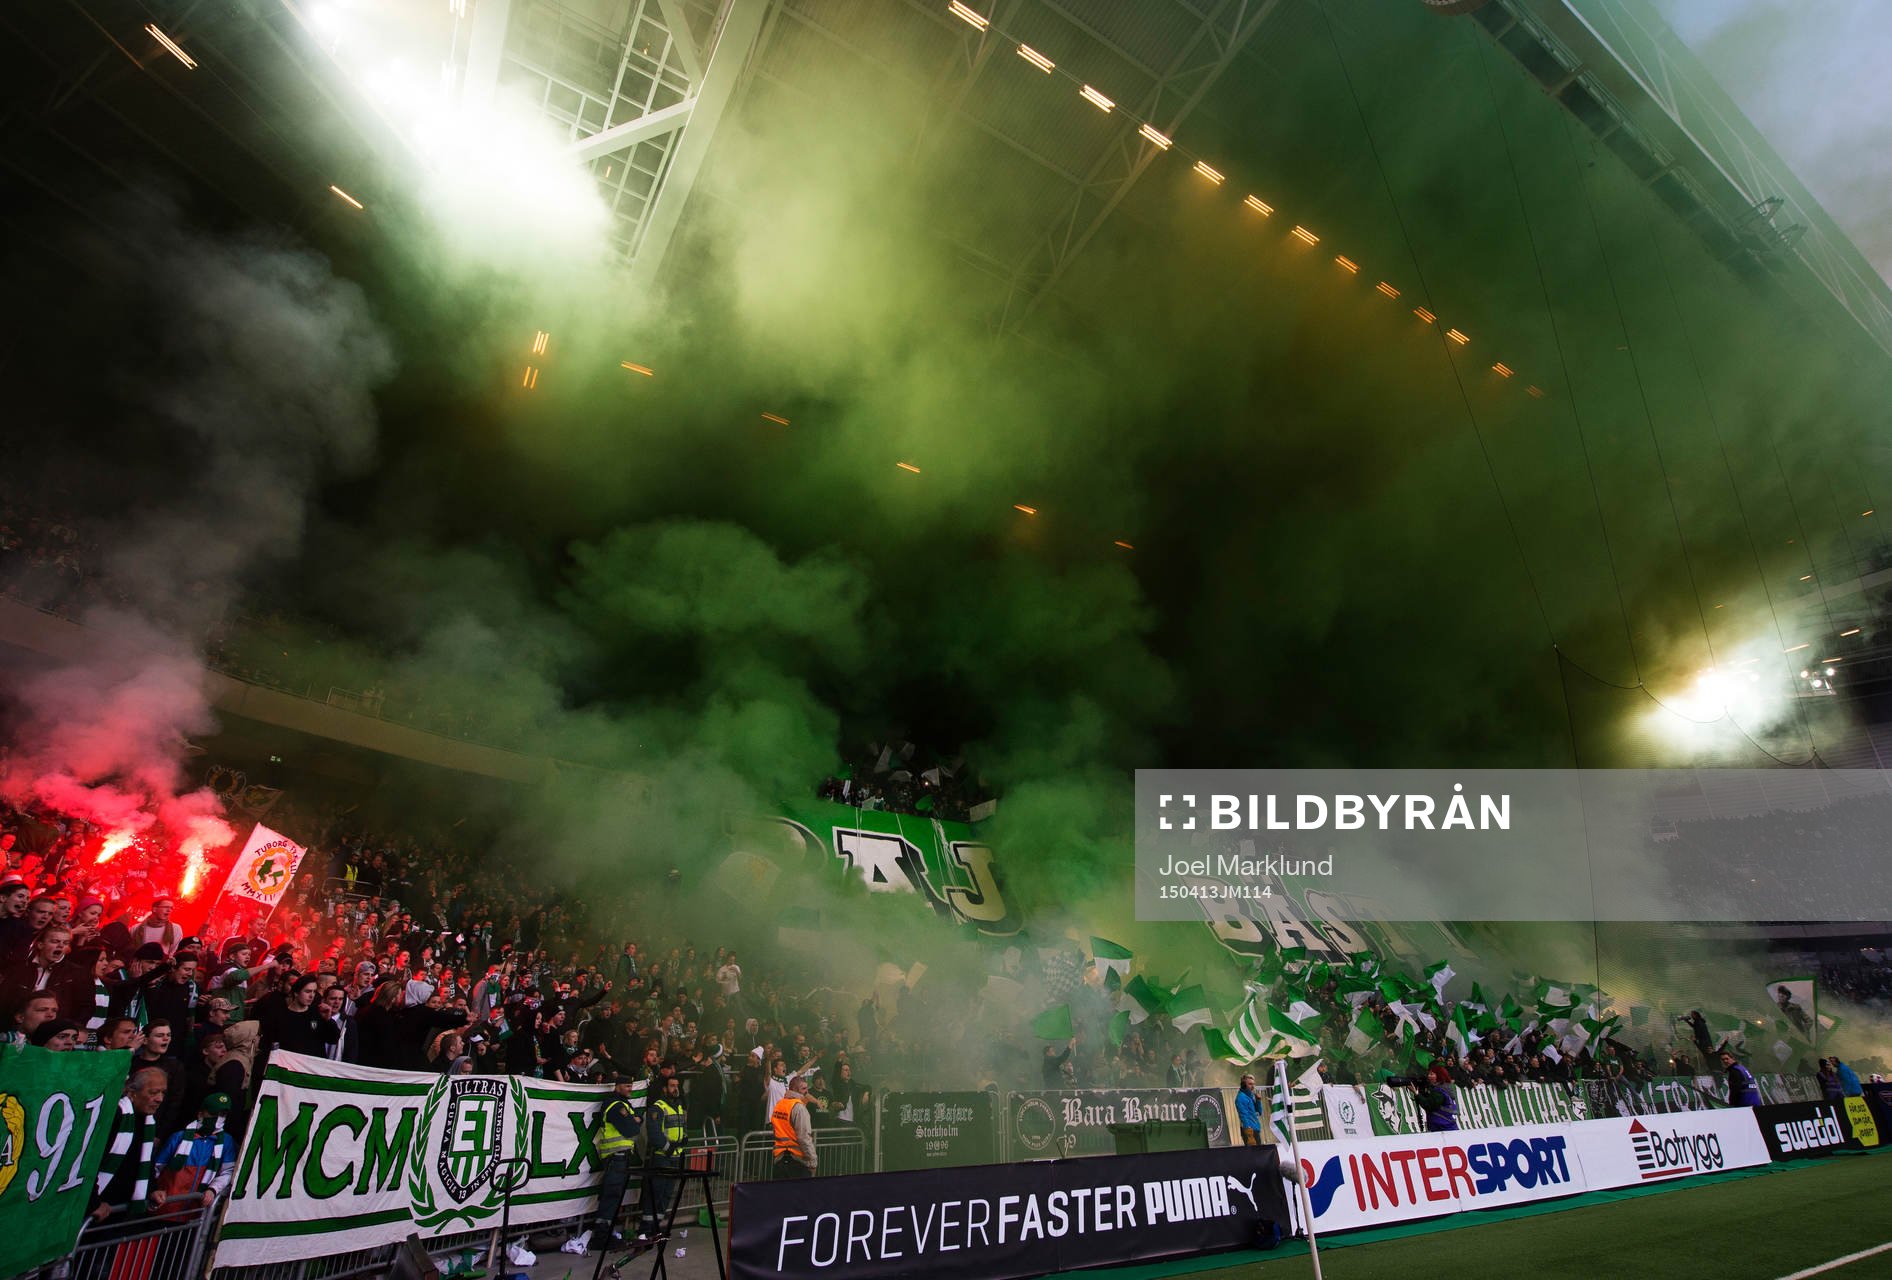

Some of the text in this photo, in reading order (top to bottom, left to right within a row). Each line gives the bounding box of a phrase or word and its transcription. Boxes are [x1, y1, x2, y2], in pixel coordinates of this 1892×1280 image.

[255, 841, 288, 856] TUBORG
[455, 1080, 505, 1096] ULTRAS
[1504, 1082, 1571, 1127] ULTRAS
[915, 1125, 959, 1139] Stockholm
[1061, 1098, 1116, 1131] Bara
[1775, 1105, 1845, 1152] swedol
[27, 1092, 104, 1201] 91
[233, 1094, 647, 1200] MCM LX
[1650, 1129, 1724, 1171] Botrygg
[459, 1190, 467, 1200] 13
[1349, 1135, 1571, 1212] INTERSPORT
[1144, 1174, 1230, 1225] PUMA
